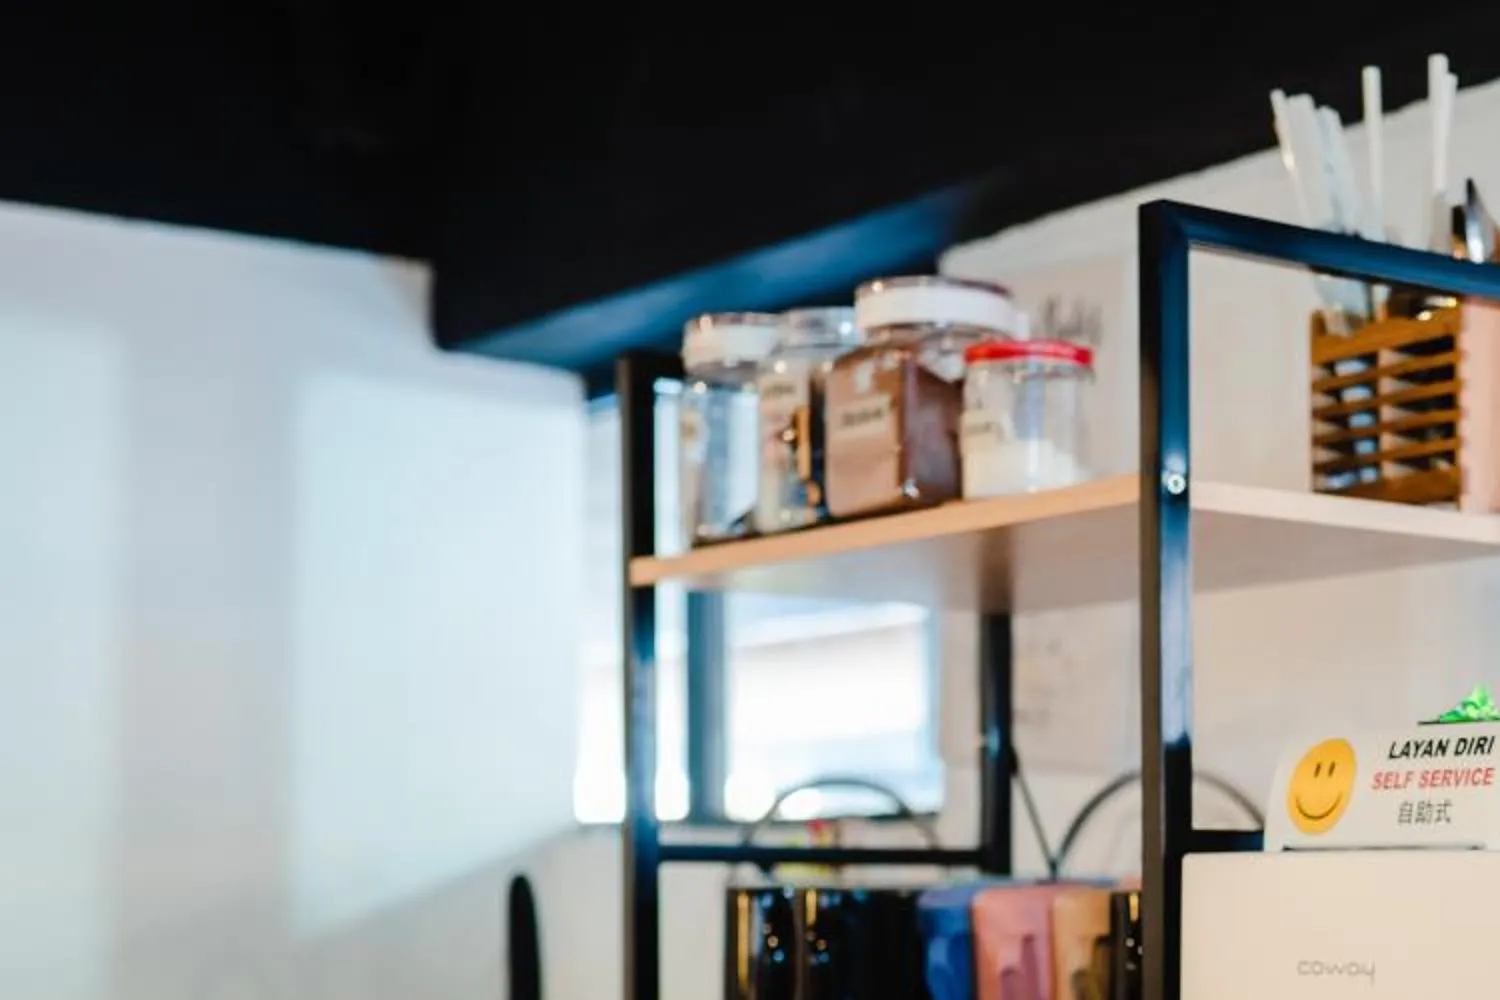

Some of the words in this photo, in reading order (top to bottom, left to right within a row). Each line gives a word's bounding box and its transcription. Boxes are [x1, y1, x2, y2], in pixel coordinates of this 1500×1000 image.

[1388, 739, 1449, 760] LAYAN
[1453, 736, 1496, 757] DIRI
[1372, 771, 1414, 790] SELF
[1417, 767, 1496, 789] SERVICE
[1397, 799, 1453, 824] 自助式
[1296, 959, 1376, 988] coway
